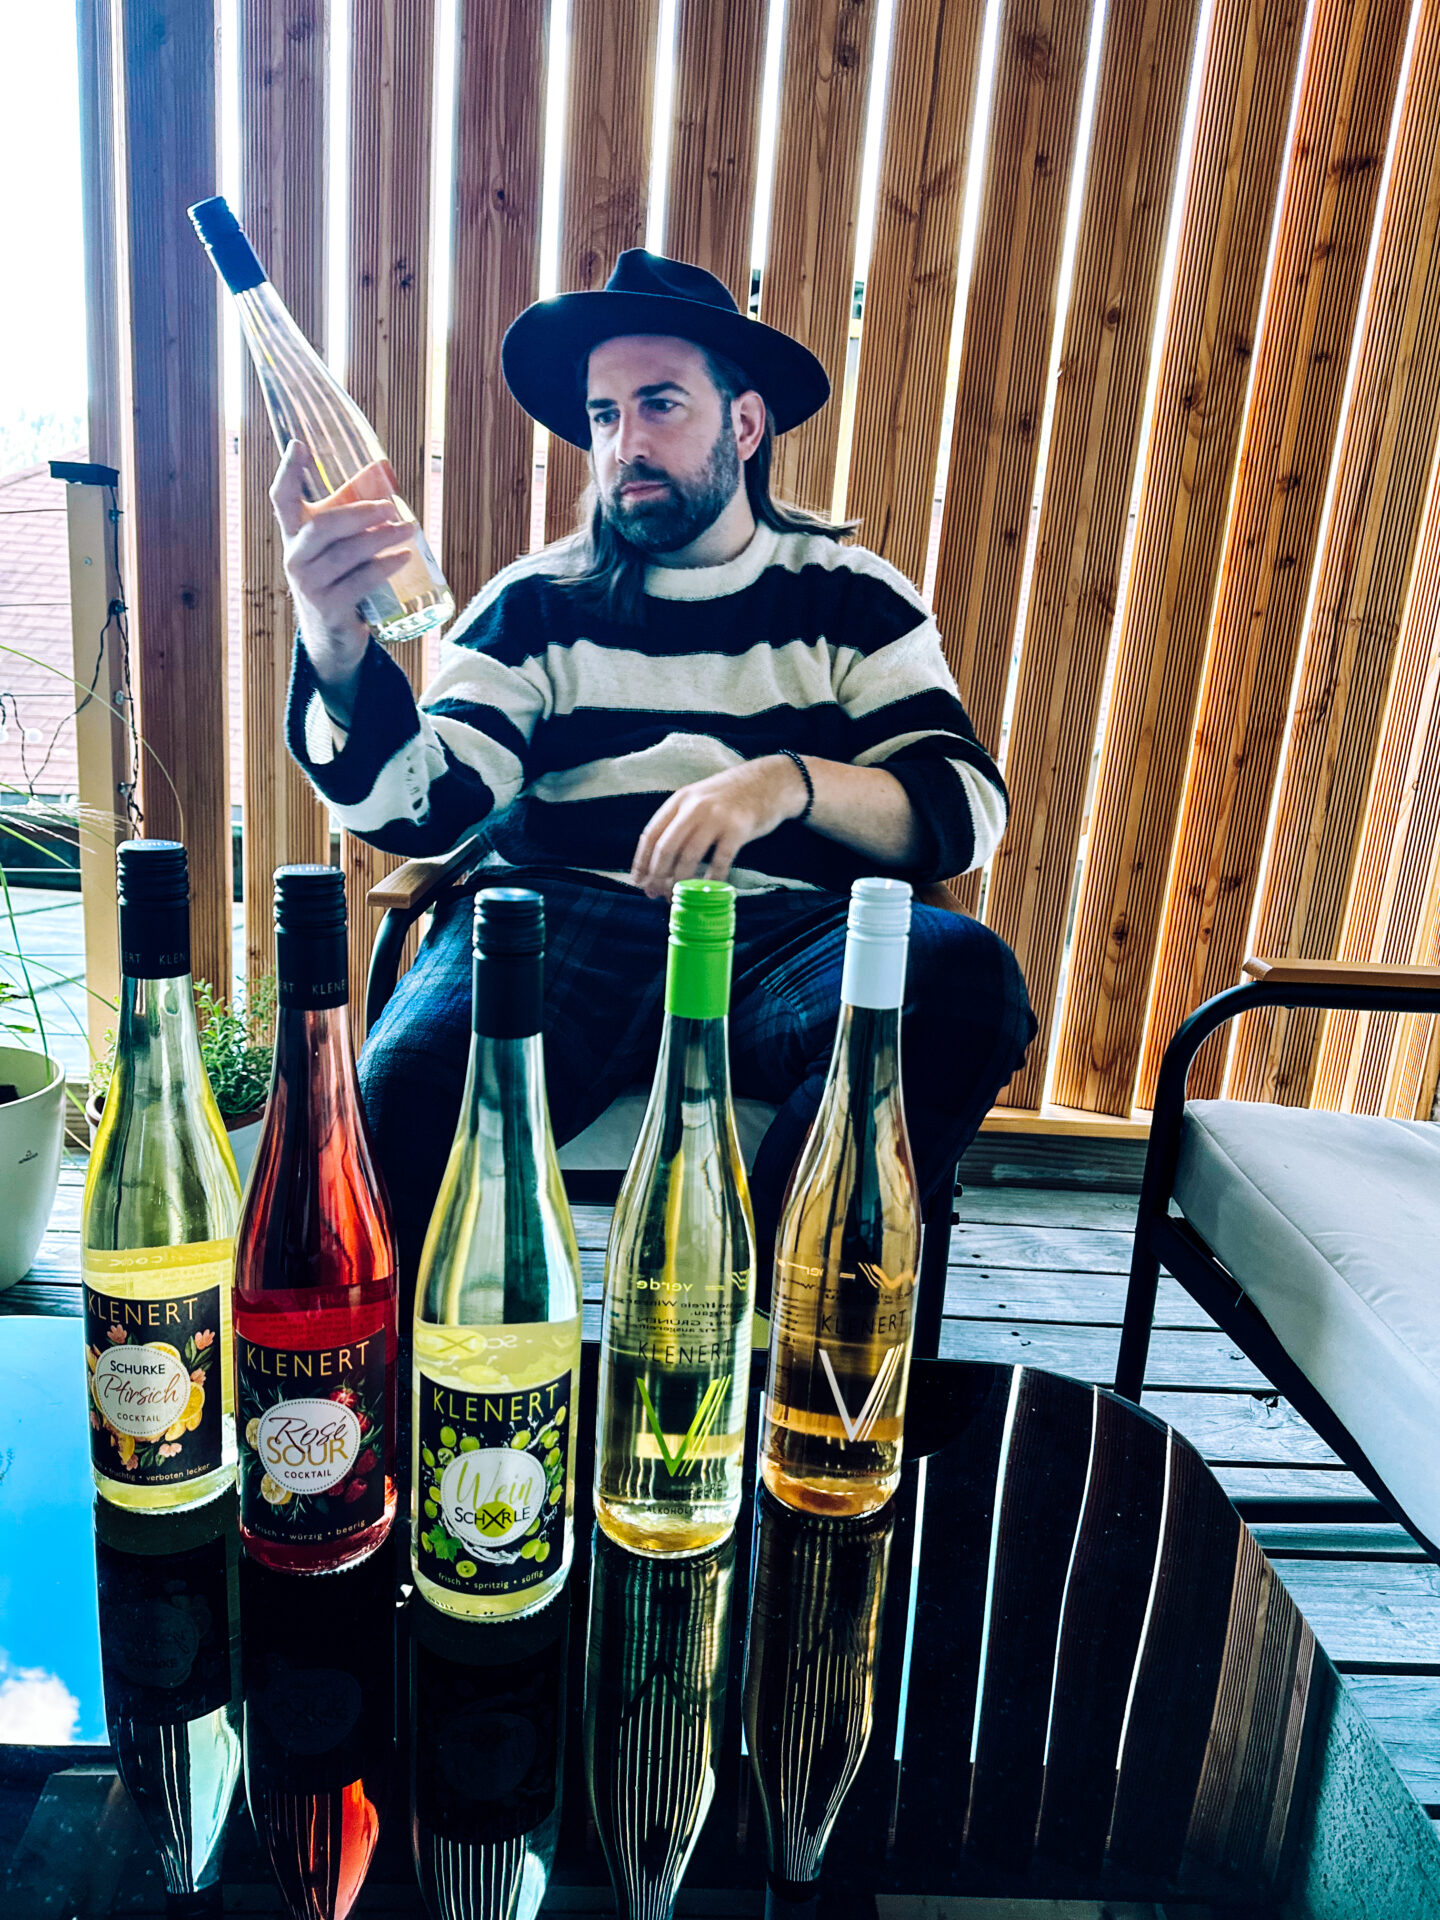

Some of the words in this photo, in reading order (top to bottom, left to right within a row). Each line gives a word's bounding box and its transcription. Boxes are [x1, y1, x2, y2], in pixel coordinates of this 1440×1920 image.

[159, 952, 187, 966] KLEN
[311, 978, 347, 995] KLENE
[88, 1290, 198, 1327] KLENERT
[822, 1309, 908, 1335] KLENERT
[246, 1340, 370, 1377] KLENERT
[638, 1337, 733, 1365] KLENERT
[110, 1360, 166, 1376] SCHURKE
[98, 1372, 181, 1405] Pfirsich
[433, 1382, 560, 1423] KLENERT
[116, 1412, 161, 1423] COCKTAIL
[268, 1415, 349, 1448] Rosé
[267, 1434, 349, 1467] SOUR
[146, 1471, 184, 1482] verboten
[186, 1463, 211, 1476] lecker
[283, 1469, 332, 1480] COCKTAIL
[455, 1460, 534, 1512] Wein
[289, 1531, 324, 1542] würzig
[336, 1518, 367, 1537] beerig
[438, 1571, 462, 1587] frisch
[473, 1579, 509, 1591] spritzig
[521, 1568, 545, 1585] süffig
